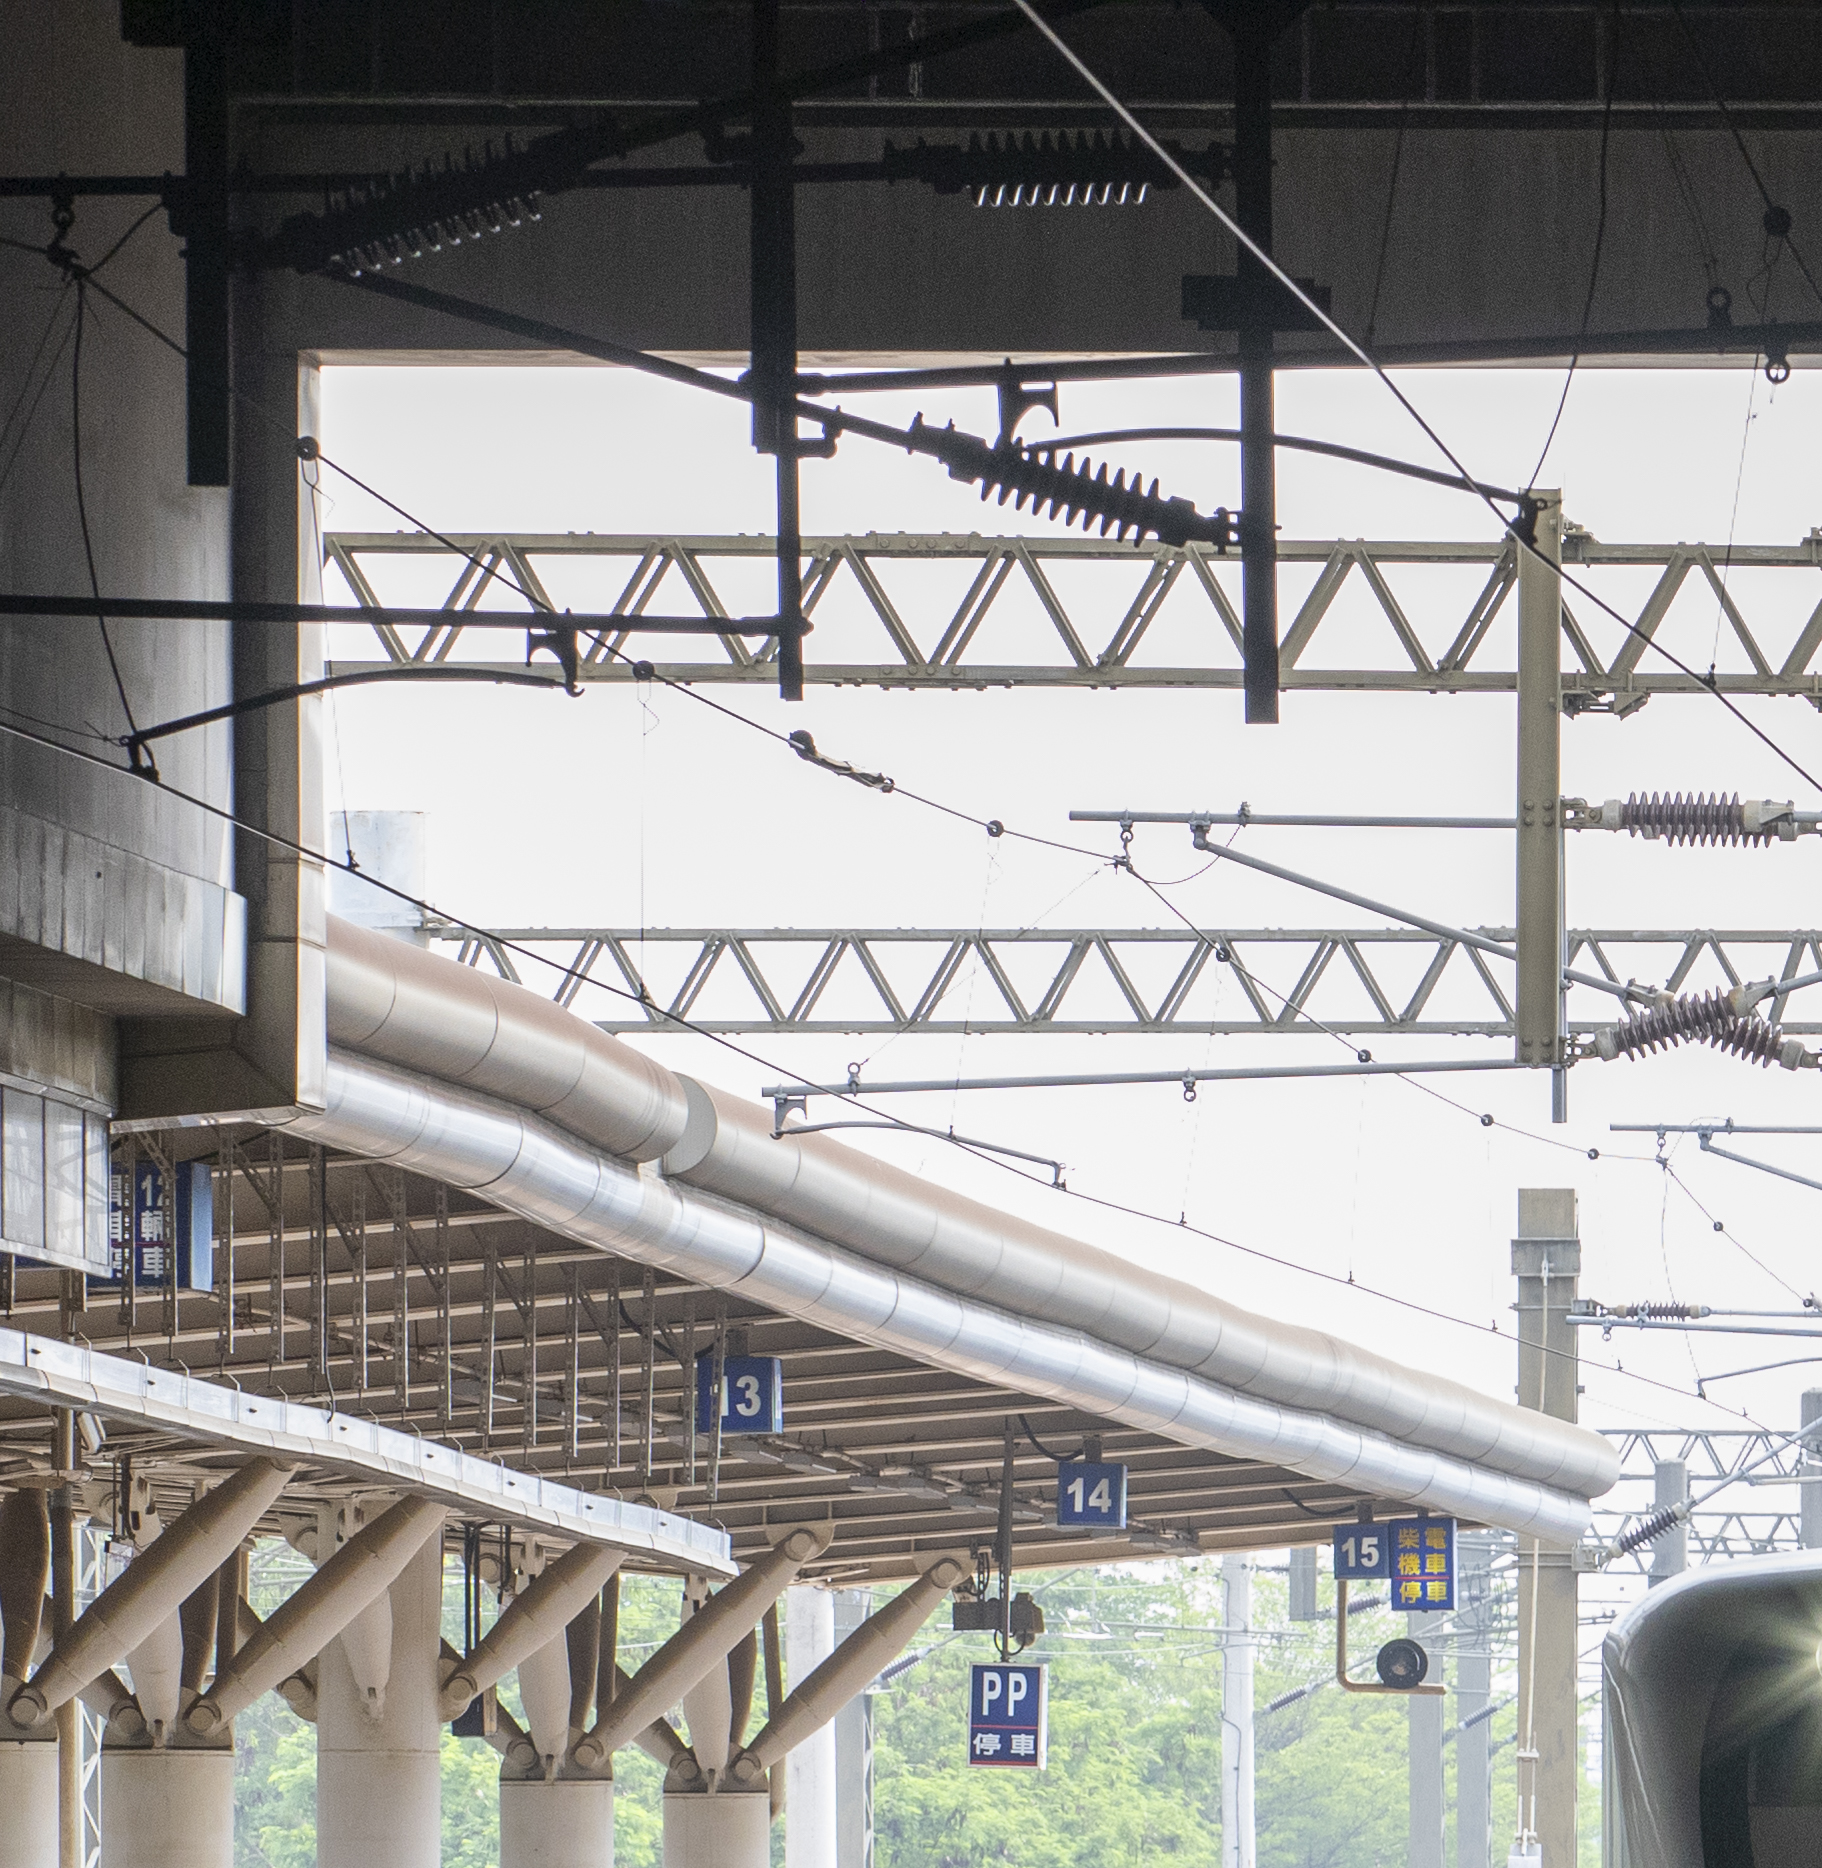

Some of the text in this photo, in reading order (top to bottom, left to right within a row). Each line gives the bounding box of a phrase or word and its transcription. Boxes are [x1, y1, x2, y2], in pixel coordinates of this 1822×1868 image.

[1067, 1477, 1112, 1513] 14
[1341, 1537, 1380, 1568] 15
[1399, 1581, 1448, 1604] 停車
[982, 1671, 1028, 1717] PP
[973, 1732, 1035, 1756] 停車
